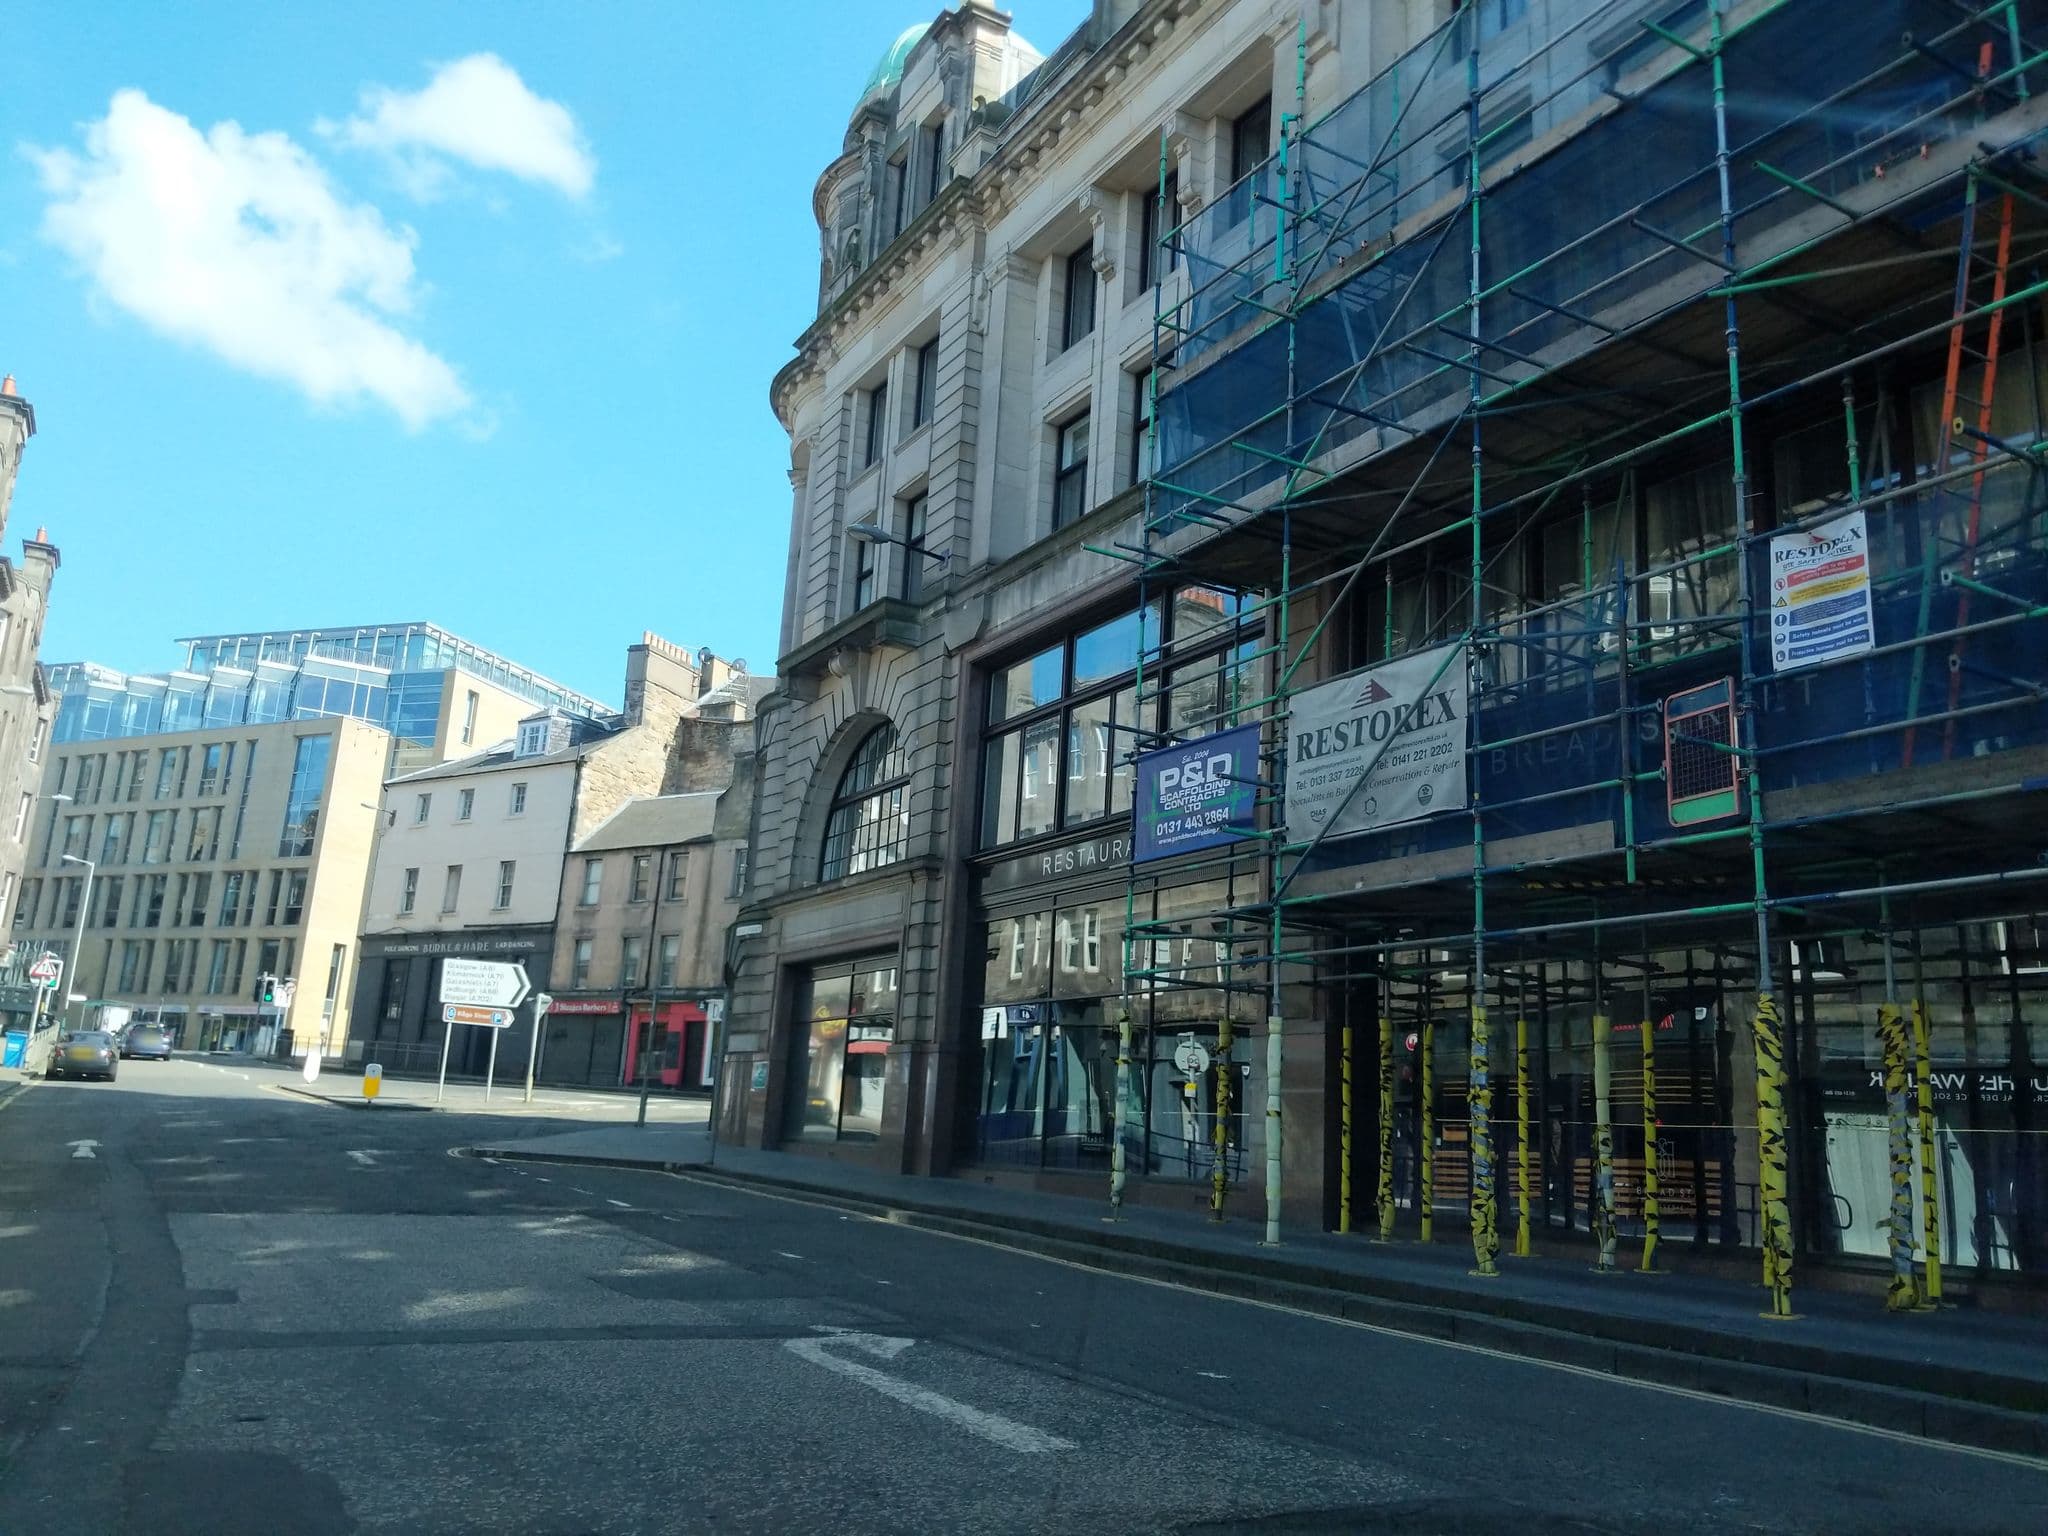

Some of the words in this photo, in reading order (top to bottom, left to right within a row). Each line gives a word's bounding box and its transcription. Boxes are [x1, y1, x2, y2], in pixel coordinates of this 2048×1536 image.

[1295, 688, 1458, 763] RESTOREX
[1391, 753, 1410, 767] 0141
[1413, 749, 1427, 761] 221
[1430, 742, 1453, 757] 2202
[1160, 752, 1232, 796] P&D
[1310, 775, 1326, 787] 0131
[1328, 770, 1343, 782] 337
[1160, 779, 1231, 804] SCAFFOLDING
[1164, 788, 1225, 811] CONTRACTS
[1184, 801, 1202, 814] LTD
[1156, 819, 1181, 836] 0131
[1184, 814, 1204, 829] 443
[1204, 807, 1229, 825] 2864
[422, 943, 451, 953] BURKE
[463, 942, 489, 951] HARE
